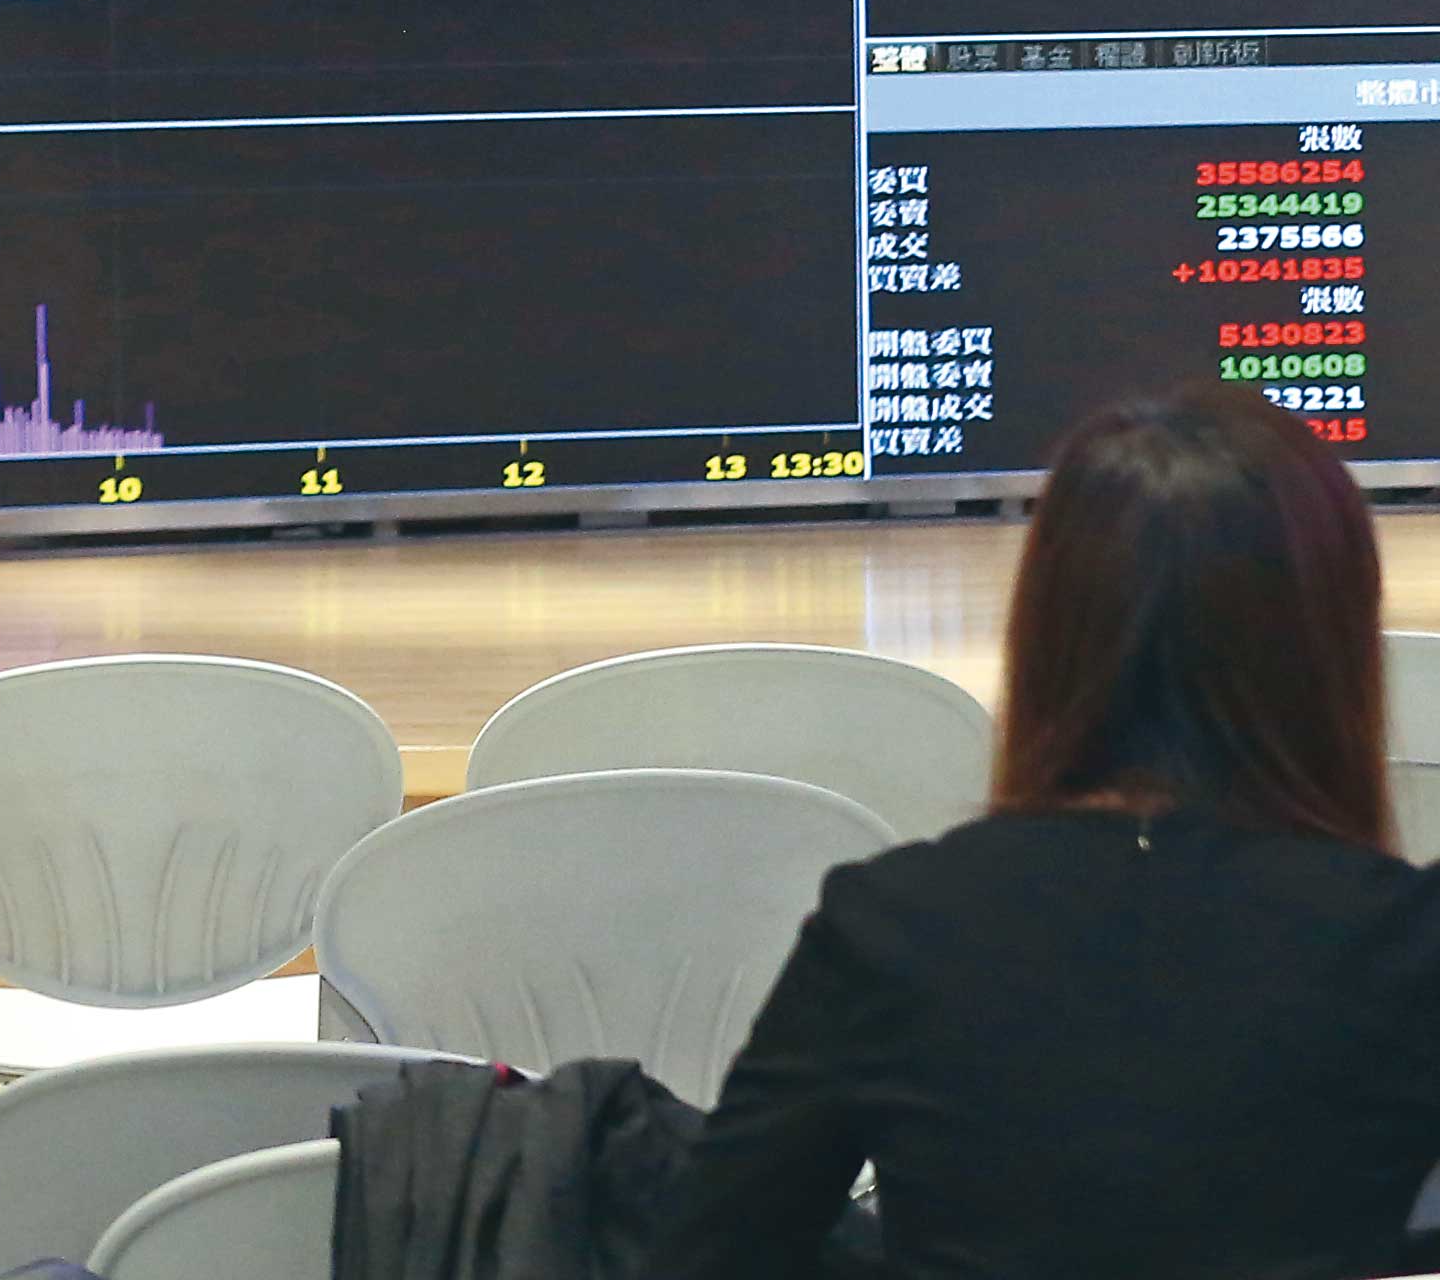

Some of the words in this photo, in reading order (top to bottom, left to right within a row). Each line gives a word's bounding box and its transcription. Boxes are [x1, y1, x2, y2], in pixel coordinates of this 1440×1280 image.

[1196, 160, 1365, 186] 35586254
[1197, 192, 1363, 218] 25344419
[1218, 224, 1363, 250] 2375566
[1172, 256, 1365, 283] +10241835
[1220, 354, 1366, 379] 1010608
[100, 478, 141, 502] 10
[302, 470, 342, 494] 11
[504, 463, 544, 486] 12
[706, 456, 746, 479] 13
[772, 452, 865, 477] 13:30
